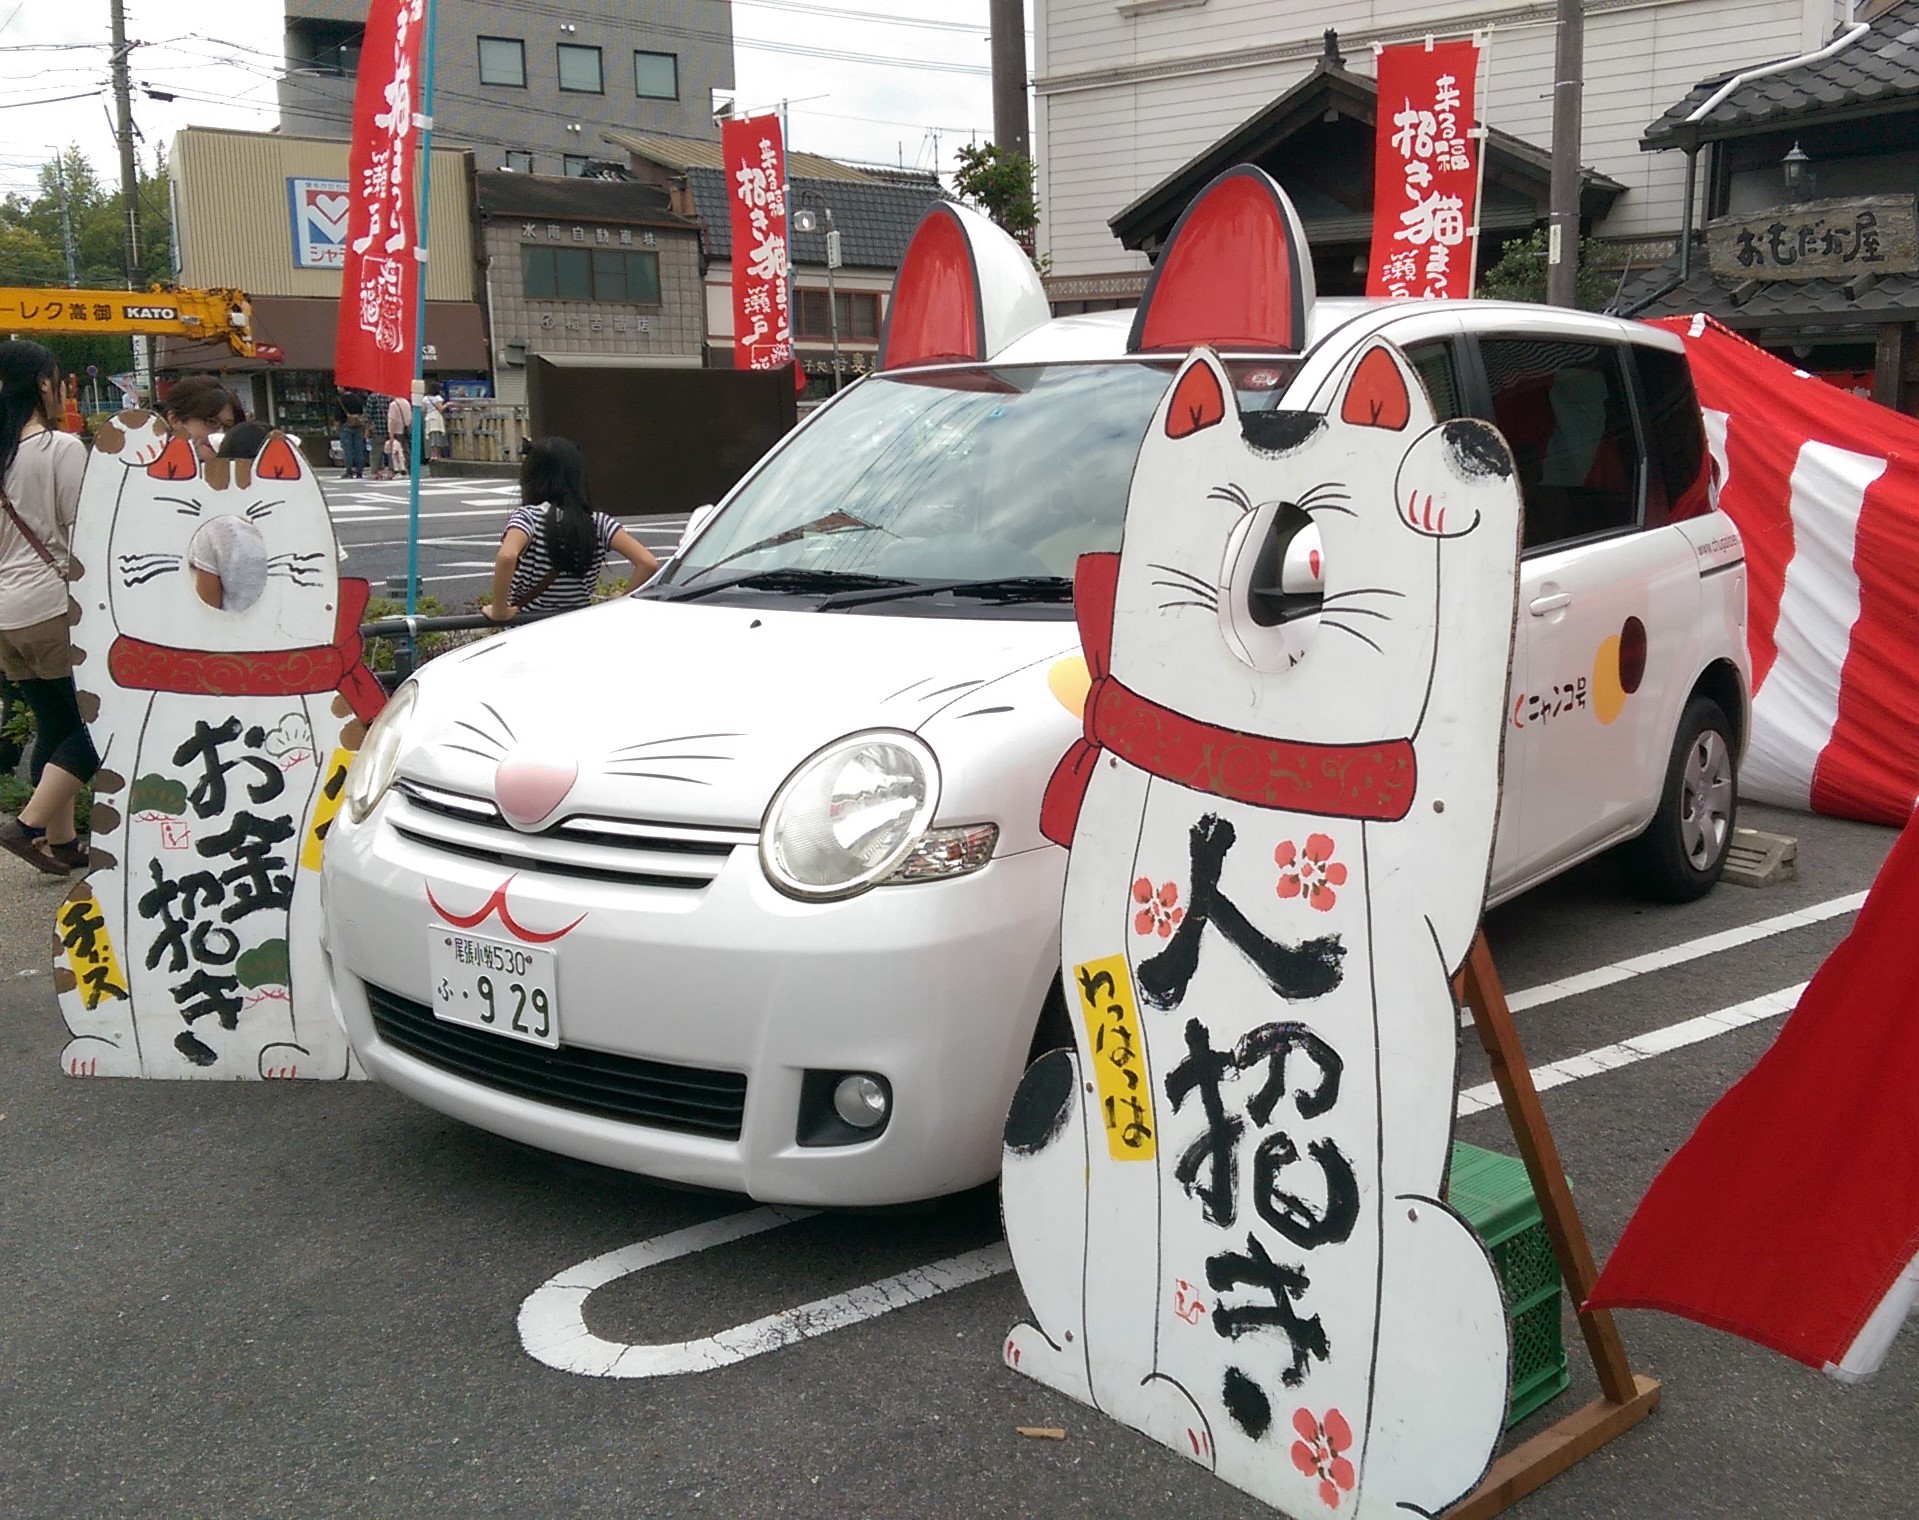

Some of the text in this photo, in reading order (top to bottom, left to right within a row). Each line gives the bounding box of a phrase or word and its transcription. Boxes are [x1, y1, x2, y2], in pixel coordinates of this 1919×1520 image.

[1434, 74, 1471, 173] 来る福
[1736, 211, 1885, 267] おもだか屋
[127, 307, 174, 320] KATO
[1509, 676, 1587, 729] くニャンコ号
[1078, 965, 1152, 1149] わっはっは
